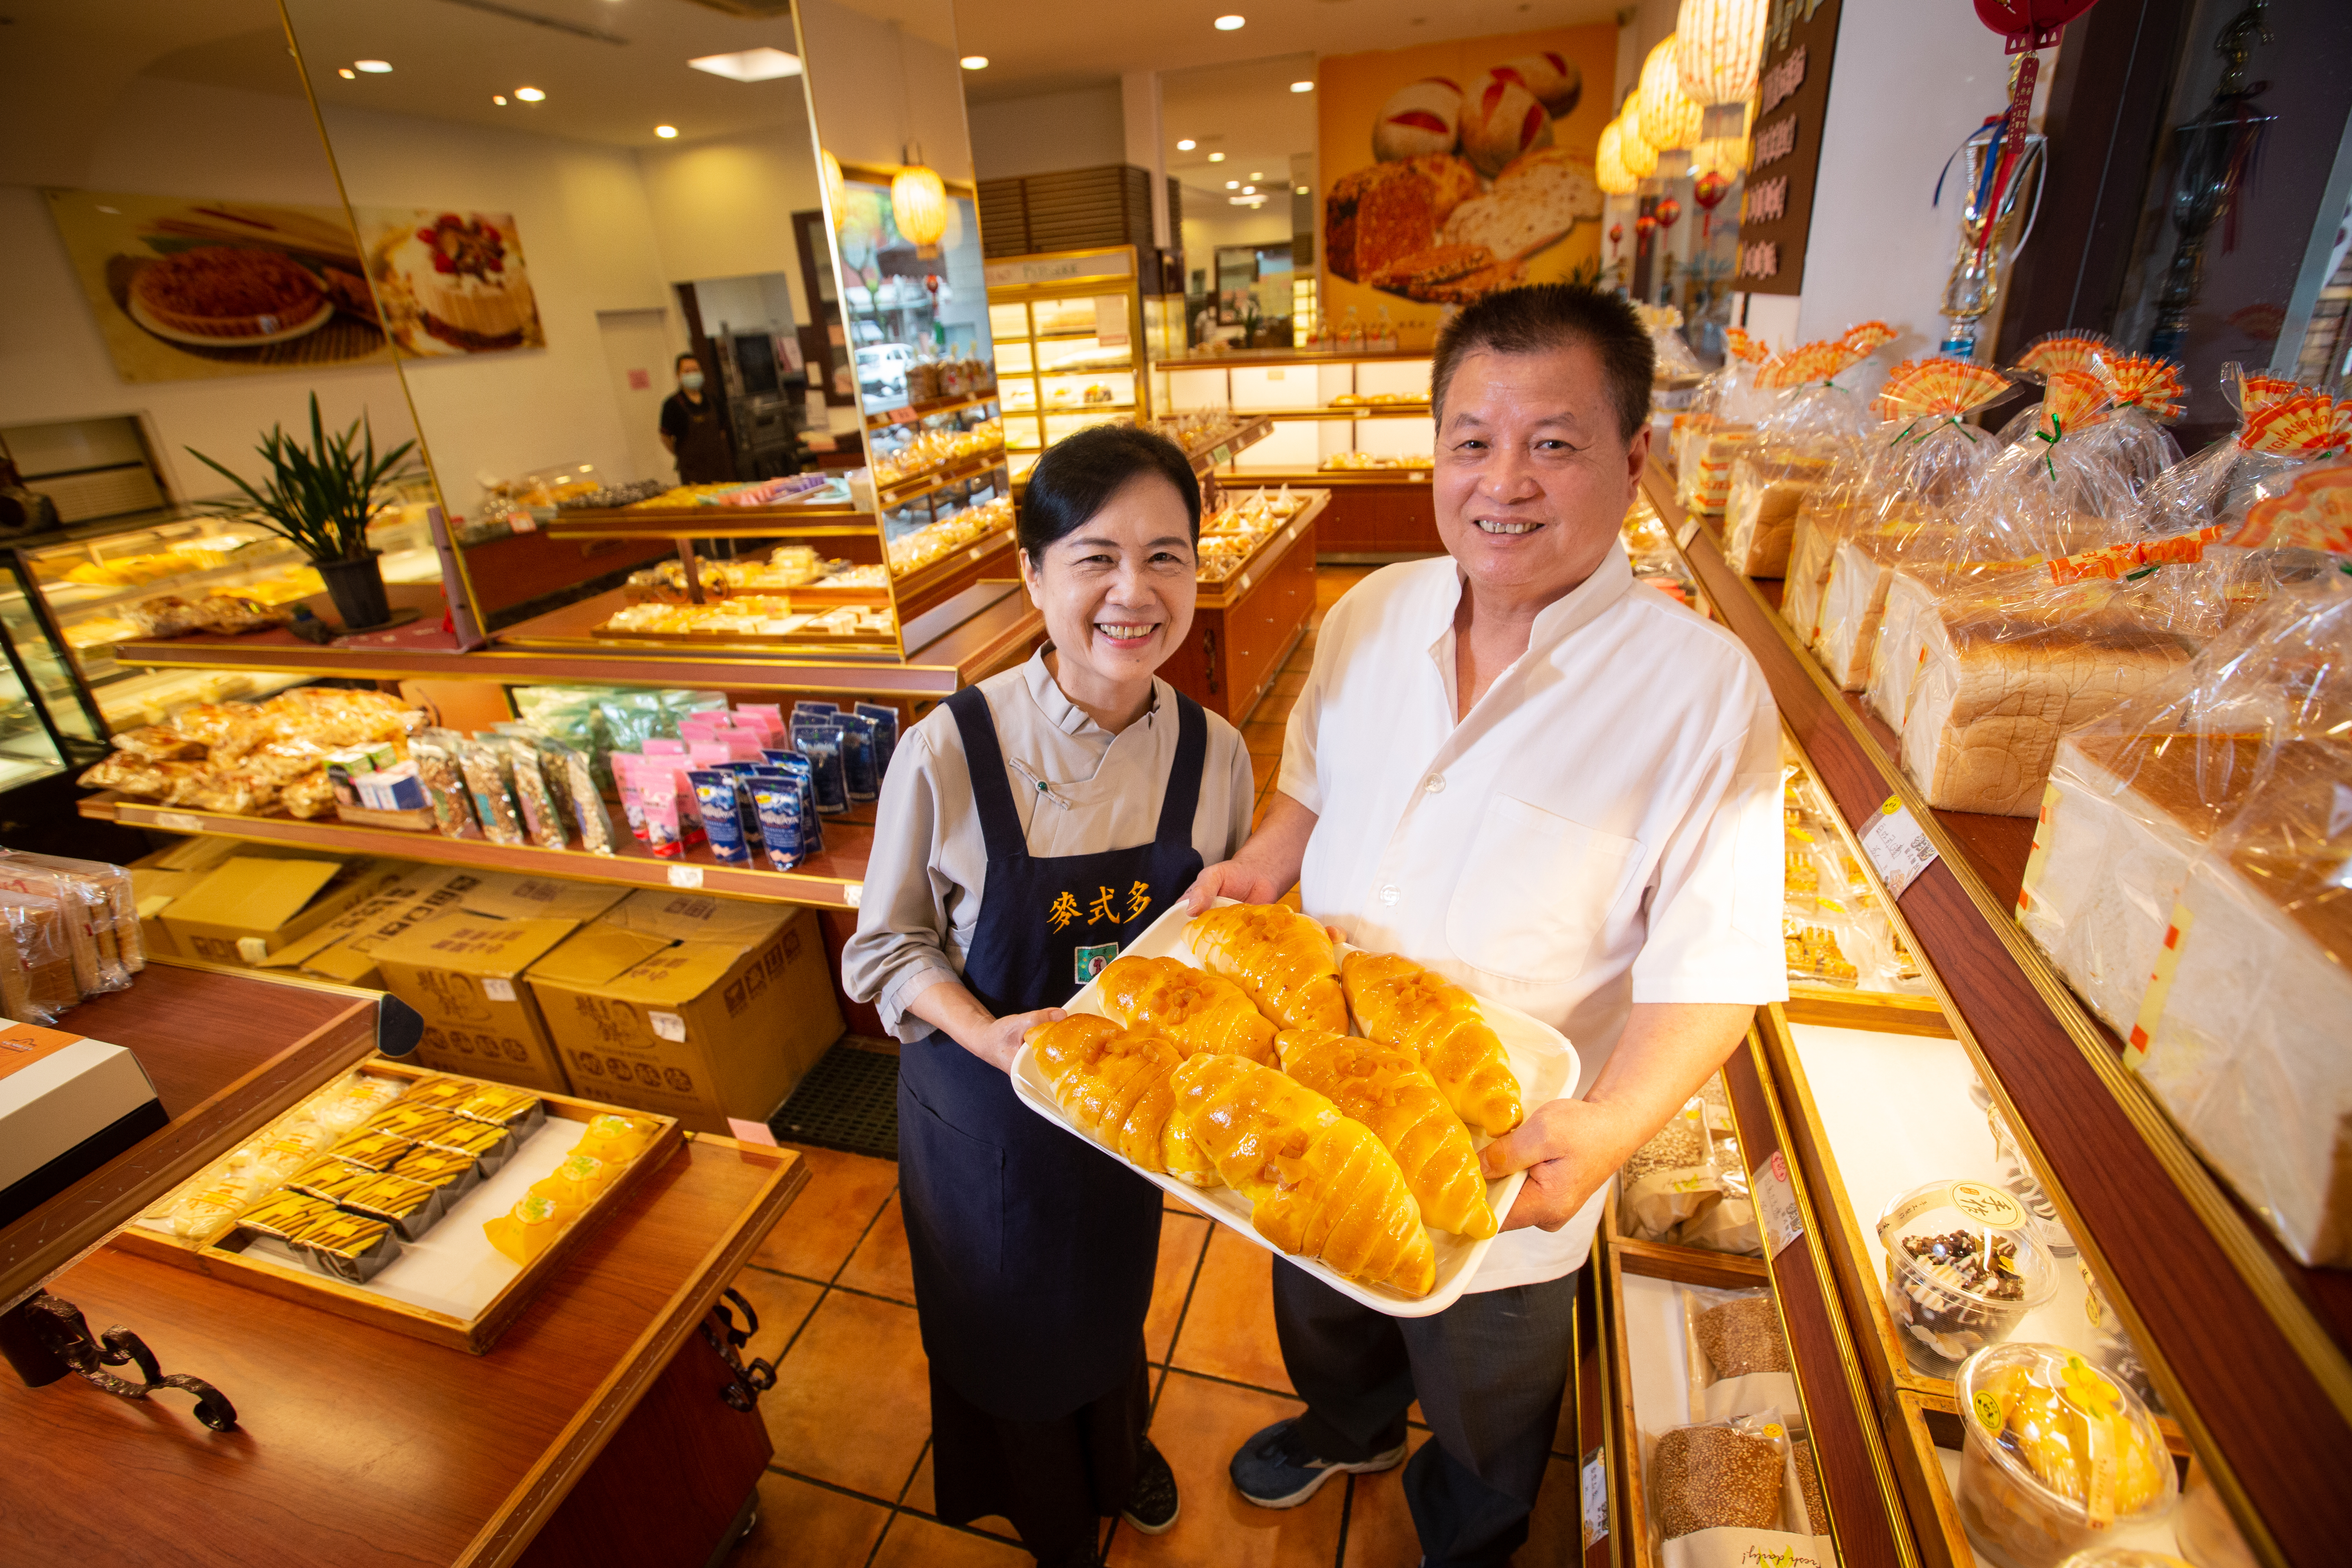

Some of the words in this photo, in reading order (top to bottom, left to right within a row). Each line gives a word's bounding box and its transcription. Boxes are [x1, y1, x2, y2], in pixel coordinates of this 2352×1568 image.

[1047, 880, 1152, 934] 麥式多
[1960, 1196, 2011, 1216] 手作
[1742, 1545, 1784, 1565] daily!
